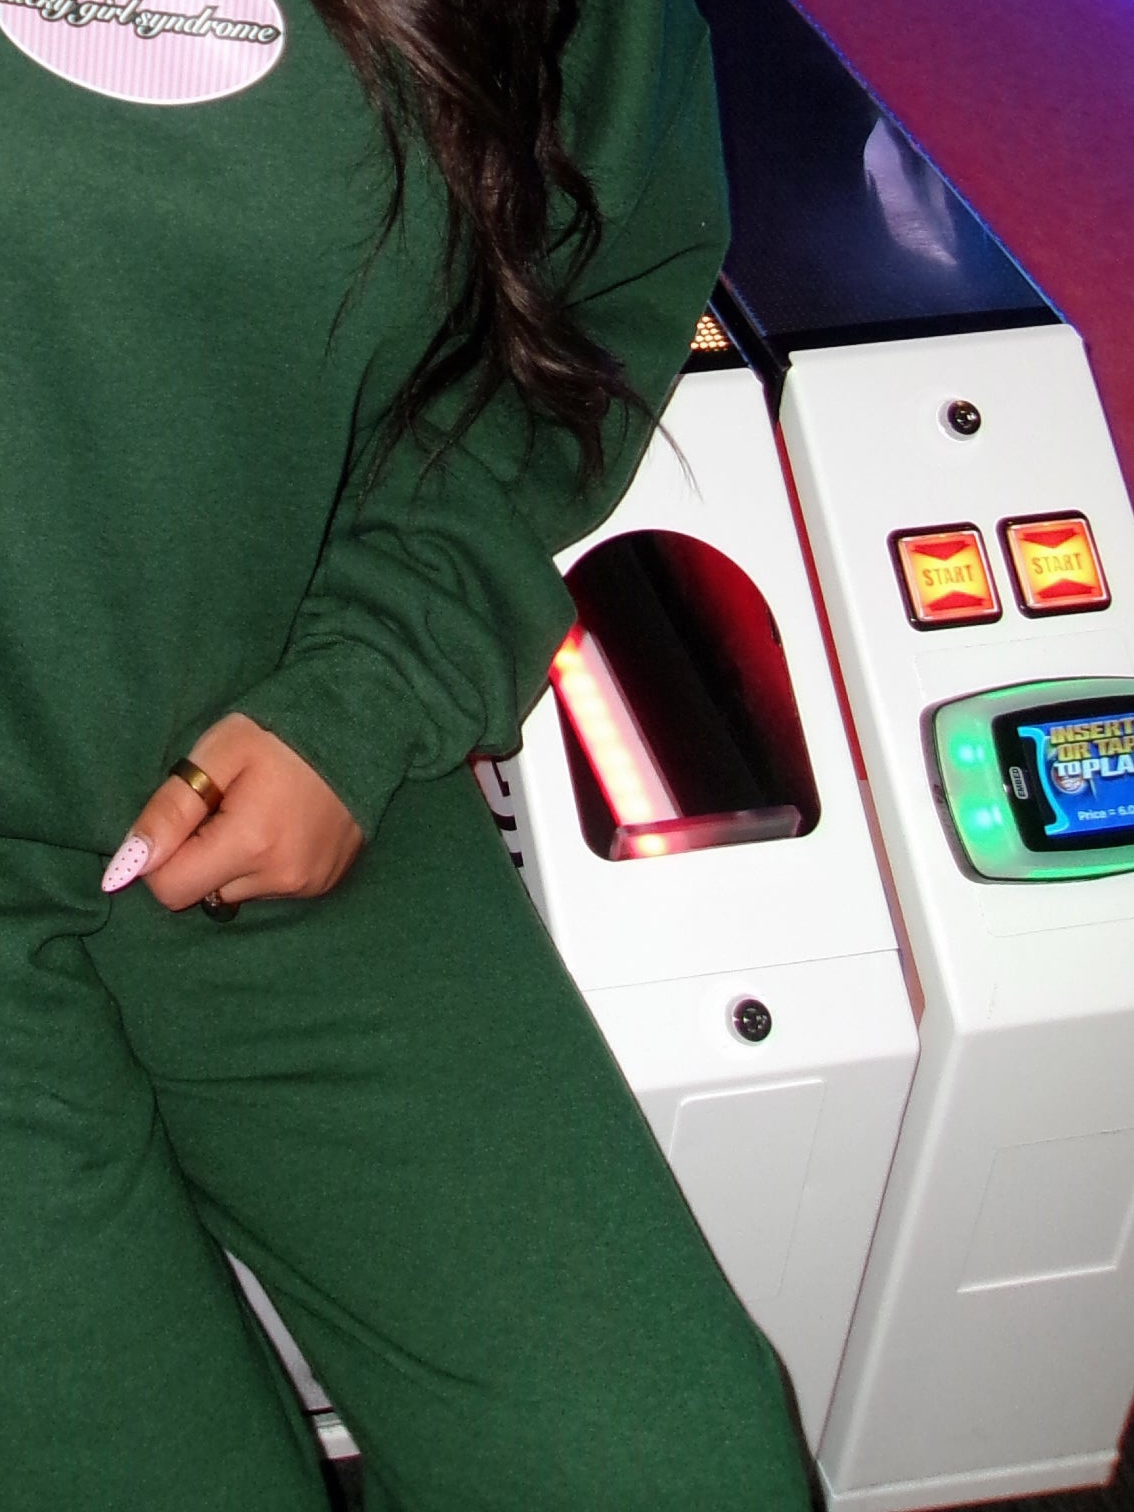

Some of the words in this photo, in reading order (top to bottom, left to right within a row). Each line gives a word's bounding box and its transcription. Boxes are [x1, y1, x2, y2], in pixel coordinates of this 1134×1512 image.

[133, 5, 282, 45] syndrome
[923, 563, 976, 587] START
[1031, 551, 1085, 576] START
[1050, 717, 1134, 744] INSERT
[1058, 741, 1091, 762] OR
